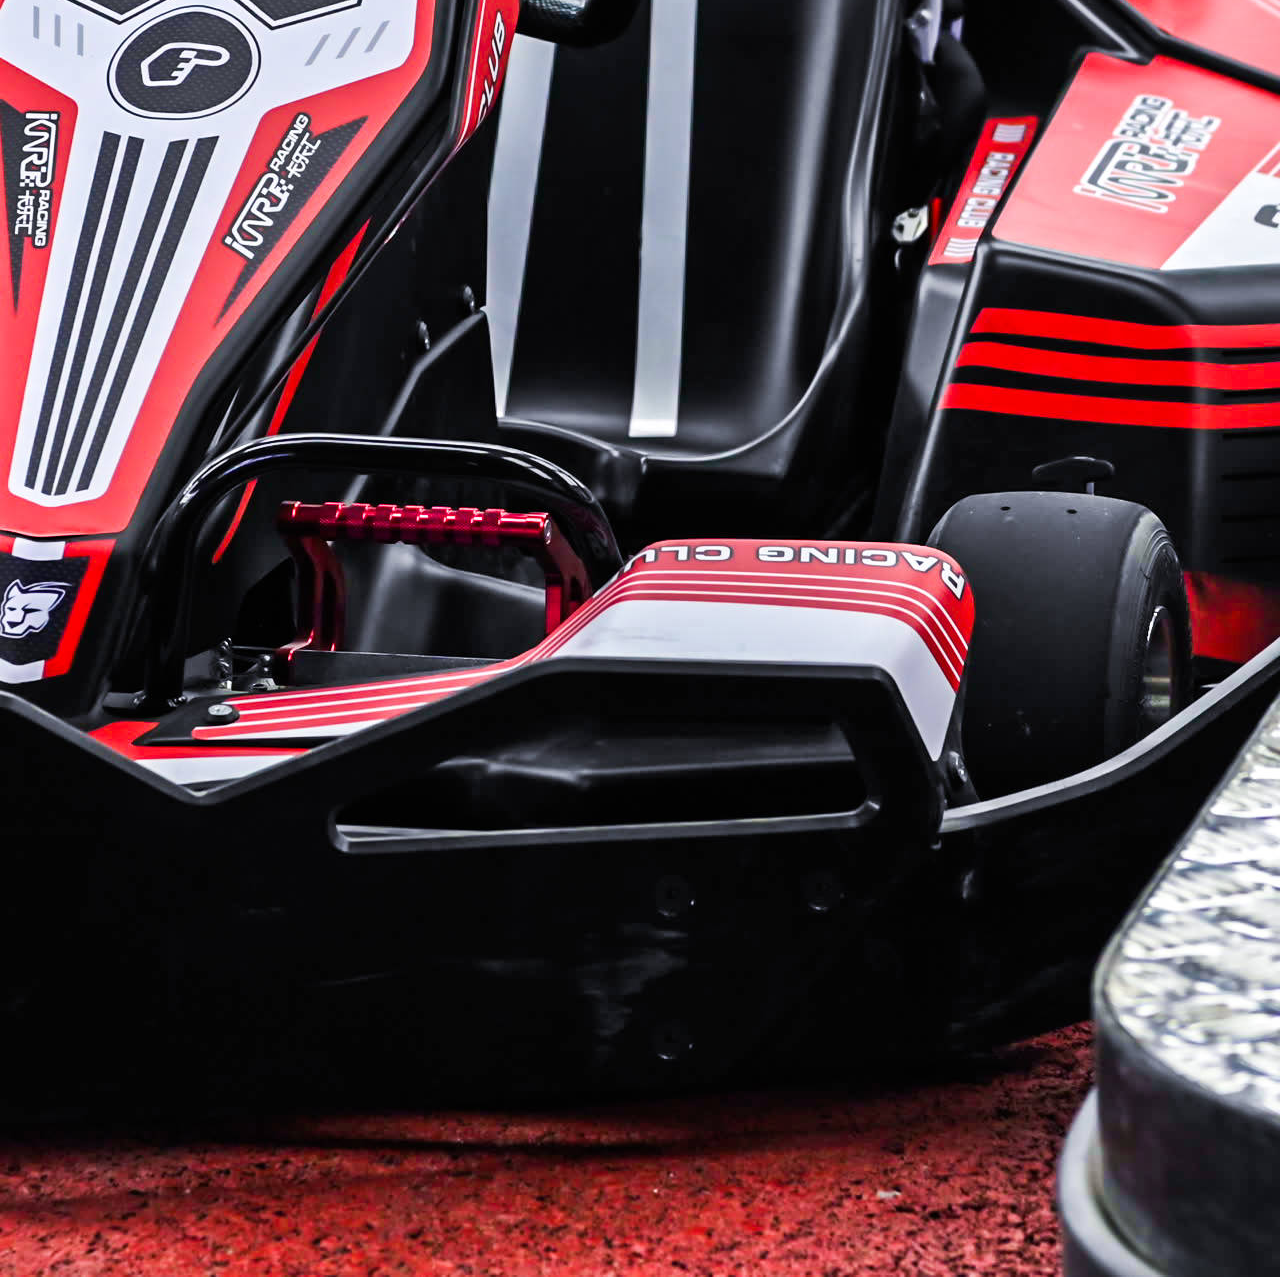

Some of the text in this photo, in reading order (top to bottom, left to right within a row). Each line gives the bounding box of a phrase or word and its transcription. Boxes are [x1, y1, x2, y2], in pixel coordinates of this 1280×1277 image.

[271, 113, 310, 172] RACING
[34, 189, 53, 248] RACING
[757, 545, 966, 601] RACING
